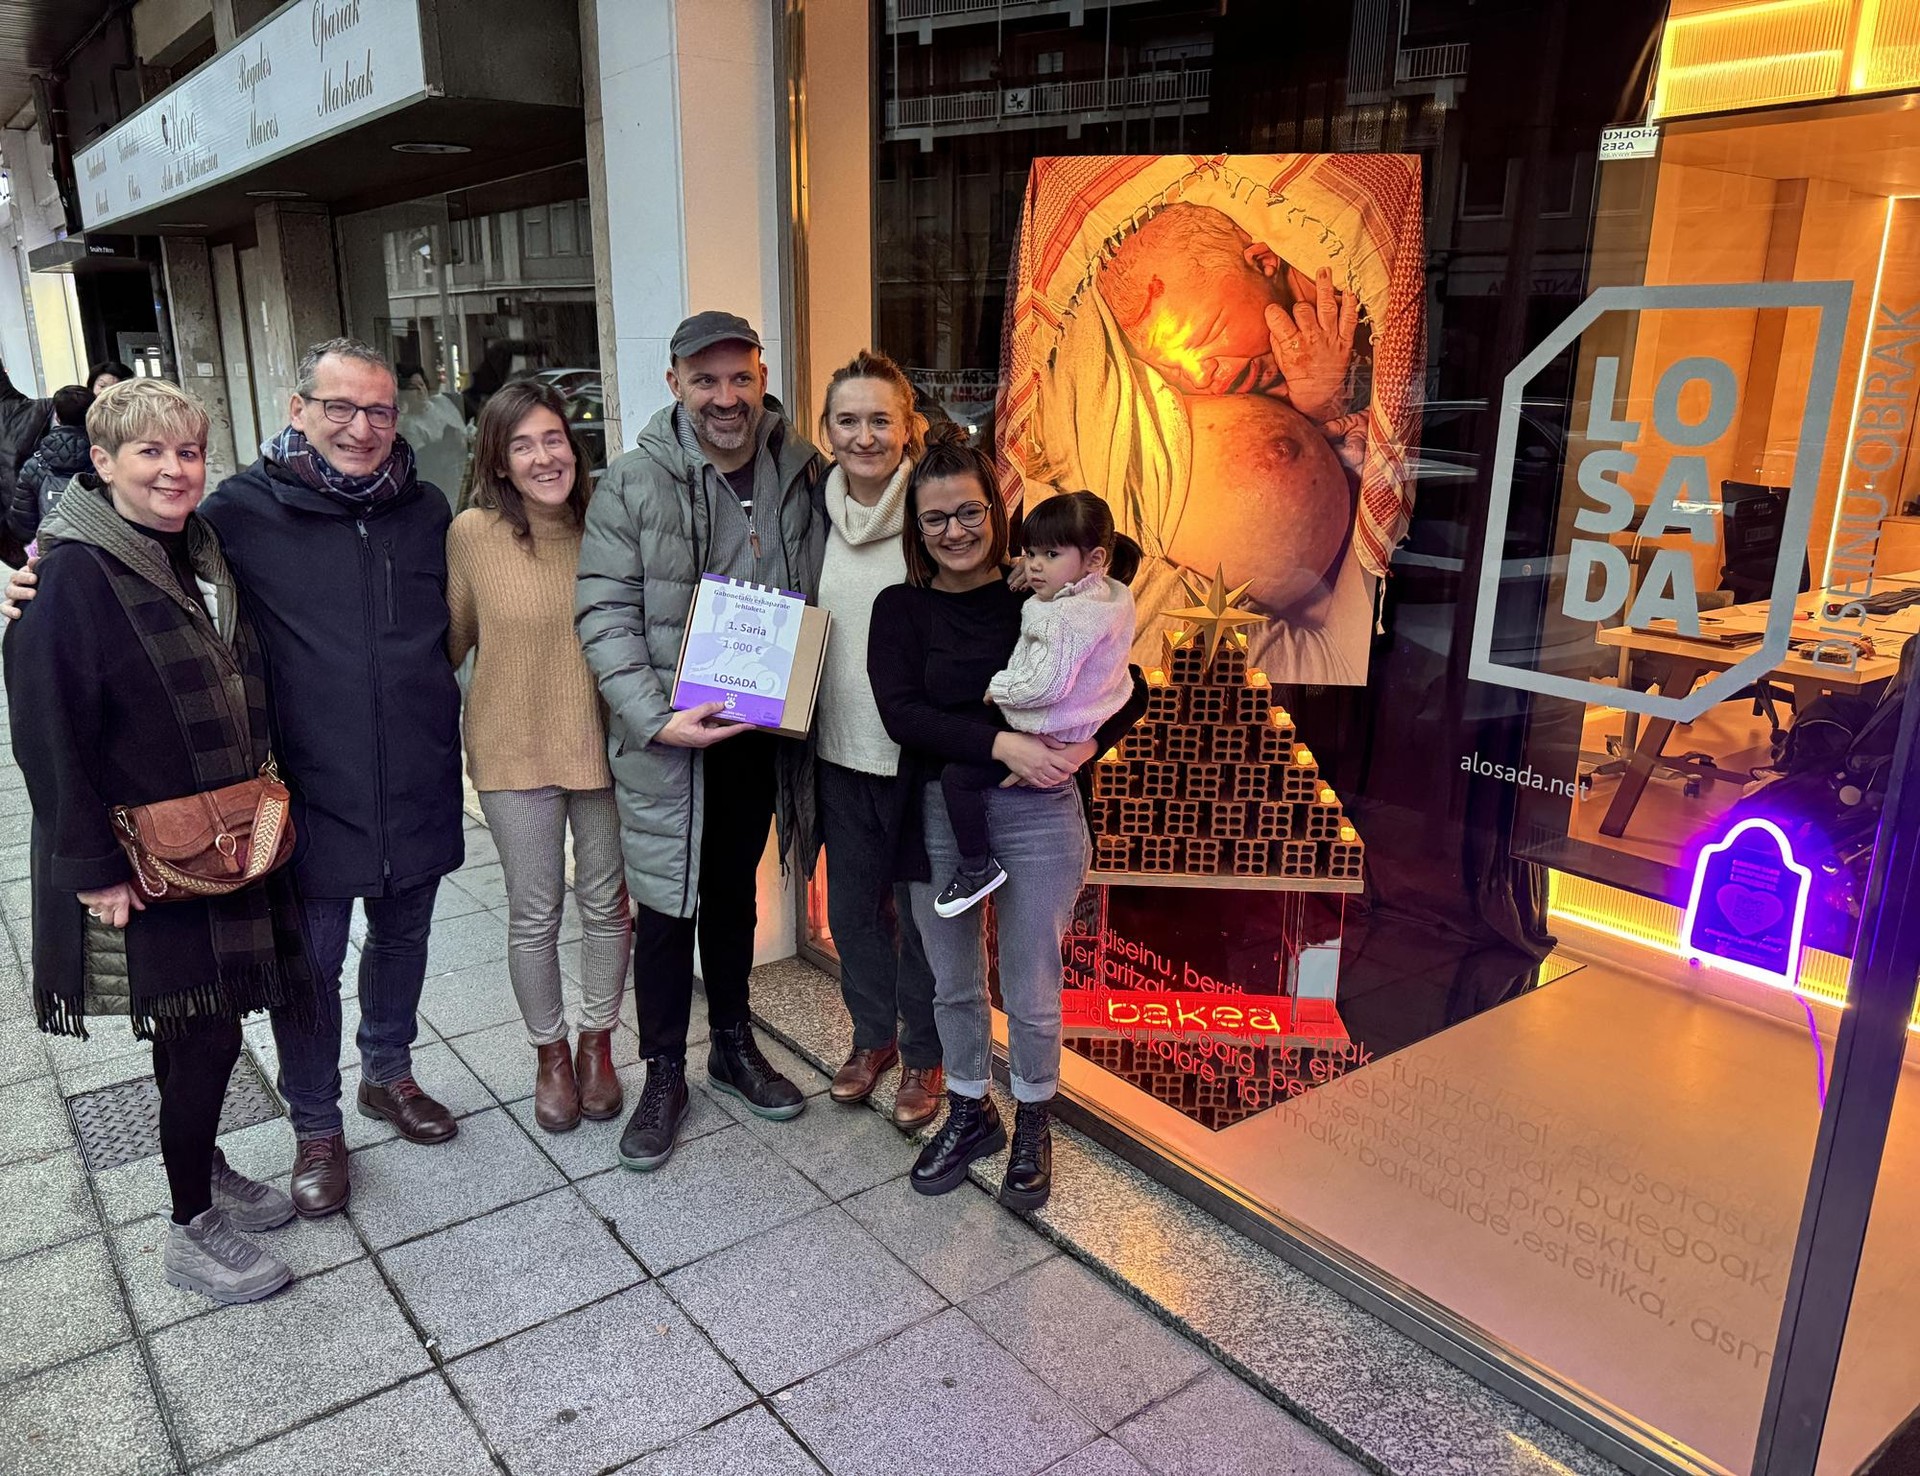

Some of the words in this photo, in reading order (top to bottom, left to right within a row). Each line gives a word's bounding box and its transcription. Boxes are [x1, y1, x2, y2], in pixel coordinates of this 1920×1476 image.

[238, 42, 272, 103] Regalos
[317, 48, 374, 117] Markoak
[246, 109, 279, 149] Marcos
[713, 589, 754, 603] Gabonetako
[754, 598, 791, 610] eskaparate
[734, 603, 766, 614] lehiaketa
[728, 621, 738, 631] 1.
[740, 623, 767, 636] Saria
[722, 640, 753, 653] 1.000
[755, 645, 763, 655] €
[713, 673, 758, 690] LOSADA
[1460, 751, 1589, 802] alosada.net
[1107, 998, 1281, 1034] bakea
